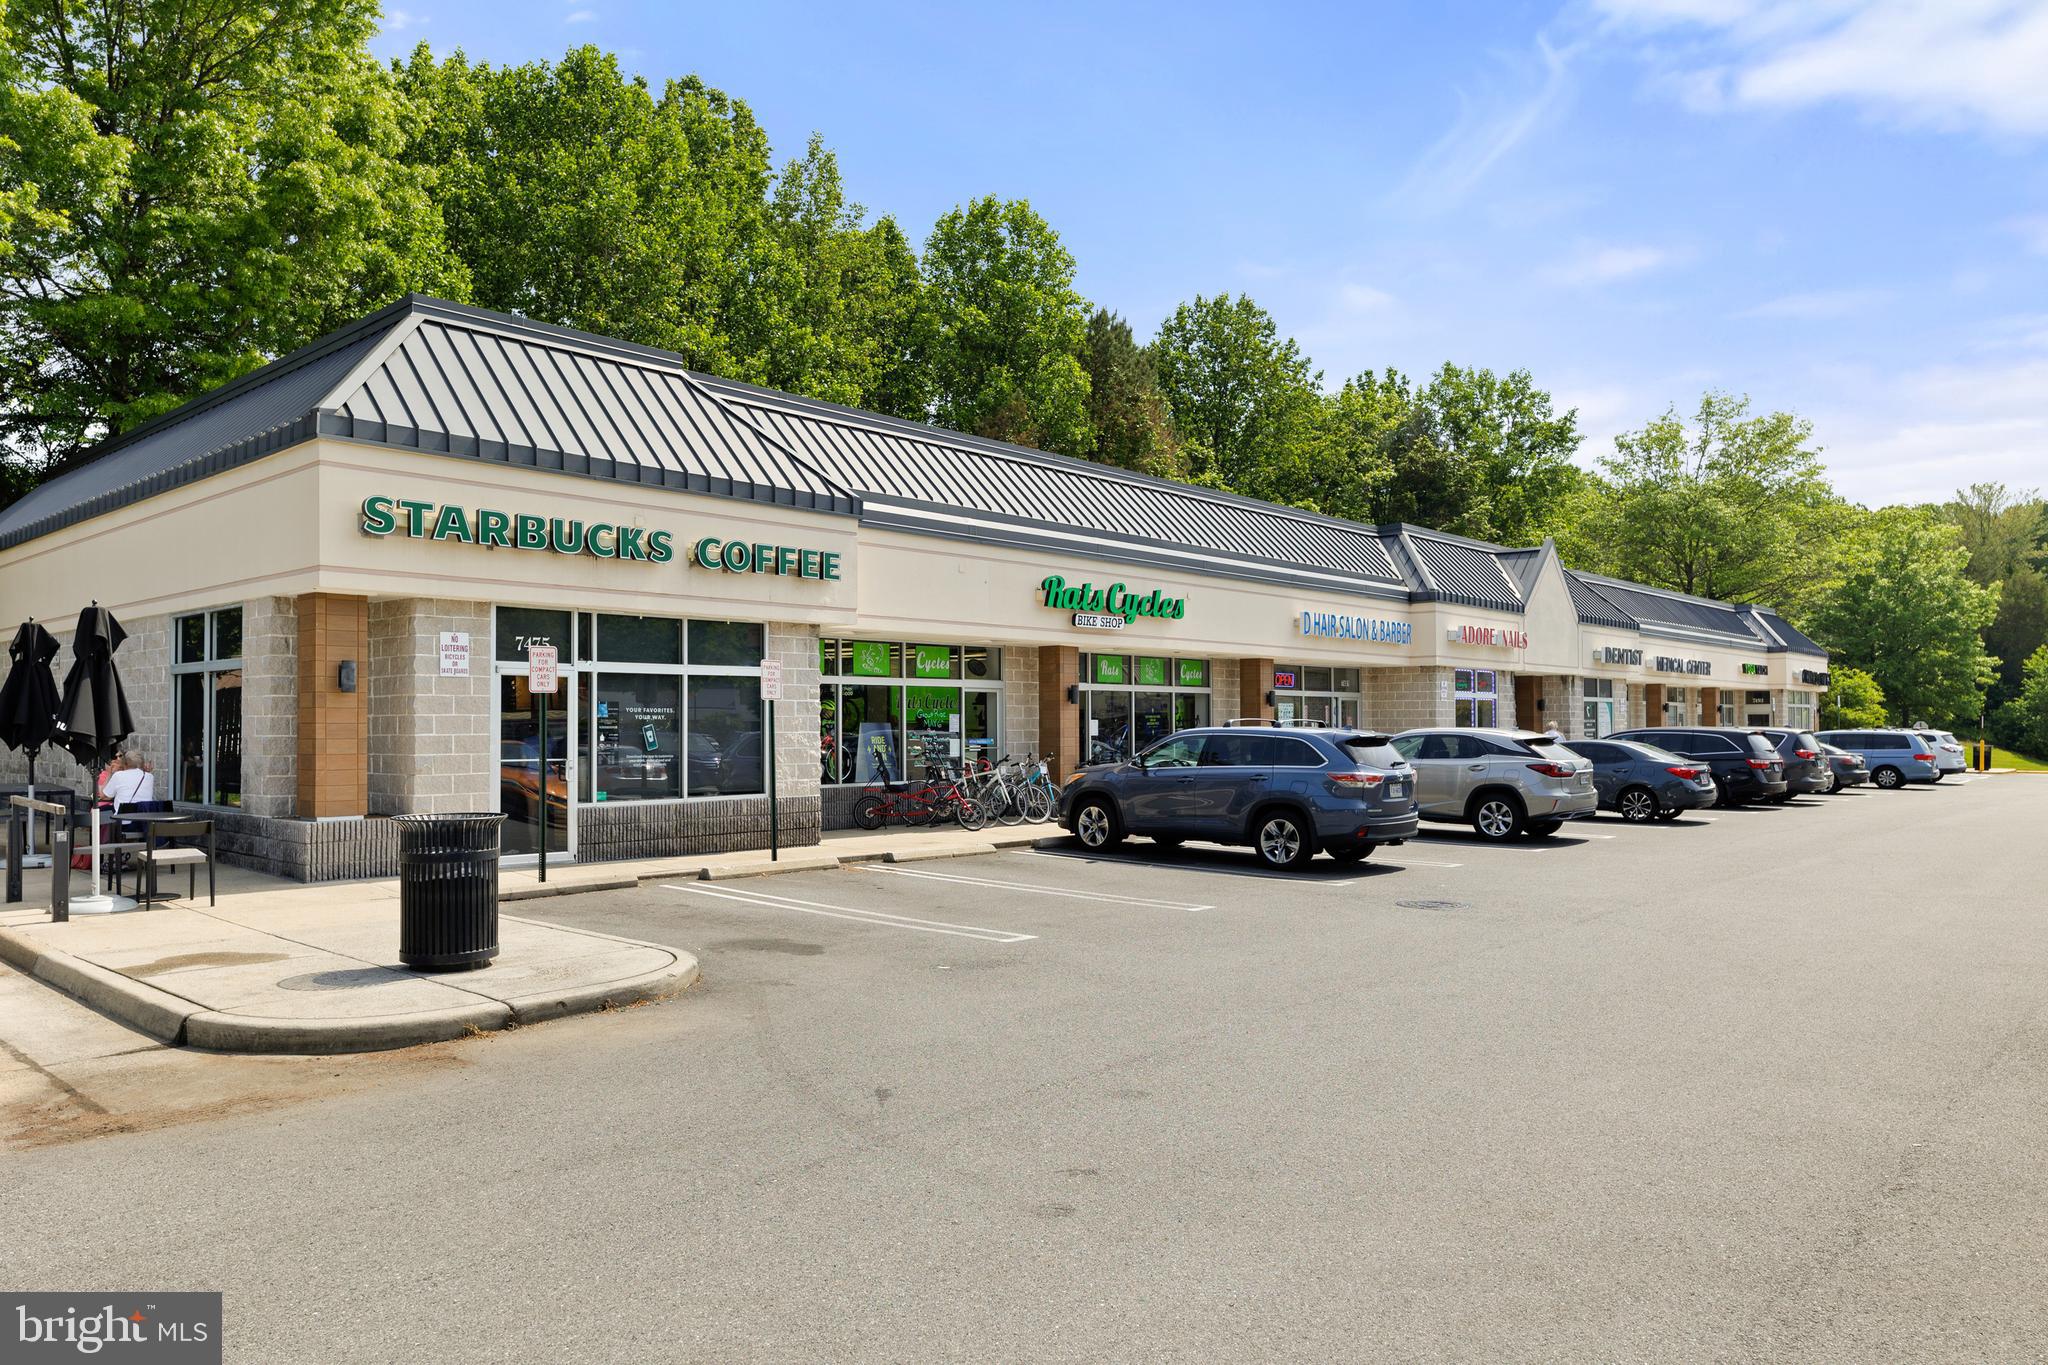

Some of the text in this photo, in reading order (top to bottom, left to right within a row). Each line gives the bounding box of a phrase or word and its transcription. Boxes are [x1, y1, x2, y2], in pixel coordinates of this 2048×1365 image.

[361, 494, 842, 581] STARBUCKS COFFEE
[1041, 575, 1185, 624] Rats Cycles
[1077, 615, 1123, 628] BIKE SHOP
[1303, 612, 1412, 645] D HAIR SALON & BARBER
[451, 635, 459, 643] NO
[515, 636, 550, 651] 7475
[1462, 625, 1528, 650] ADORE NAILS
[441, 644, 469, 652] LOITERING
[1604, 647, 1643, 665] DENTIST
[916, 651, 950, 672] Cycles
[1100, 660, 1119, 676] Rats
[1656, 656, 1711, 676] MEDICAL CENTER
[1180, 664, 1202, 680] Cycles
[1275, 674, 1293, 686] OPEN
[925, 693, 957, 710] Cycle
[871, 735, 886, 745] RIDE
